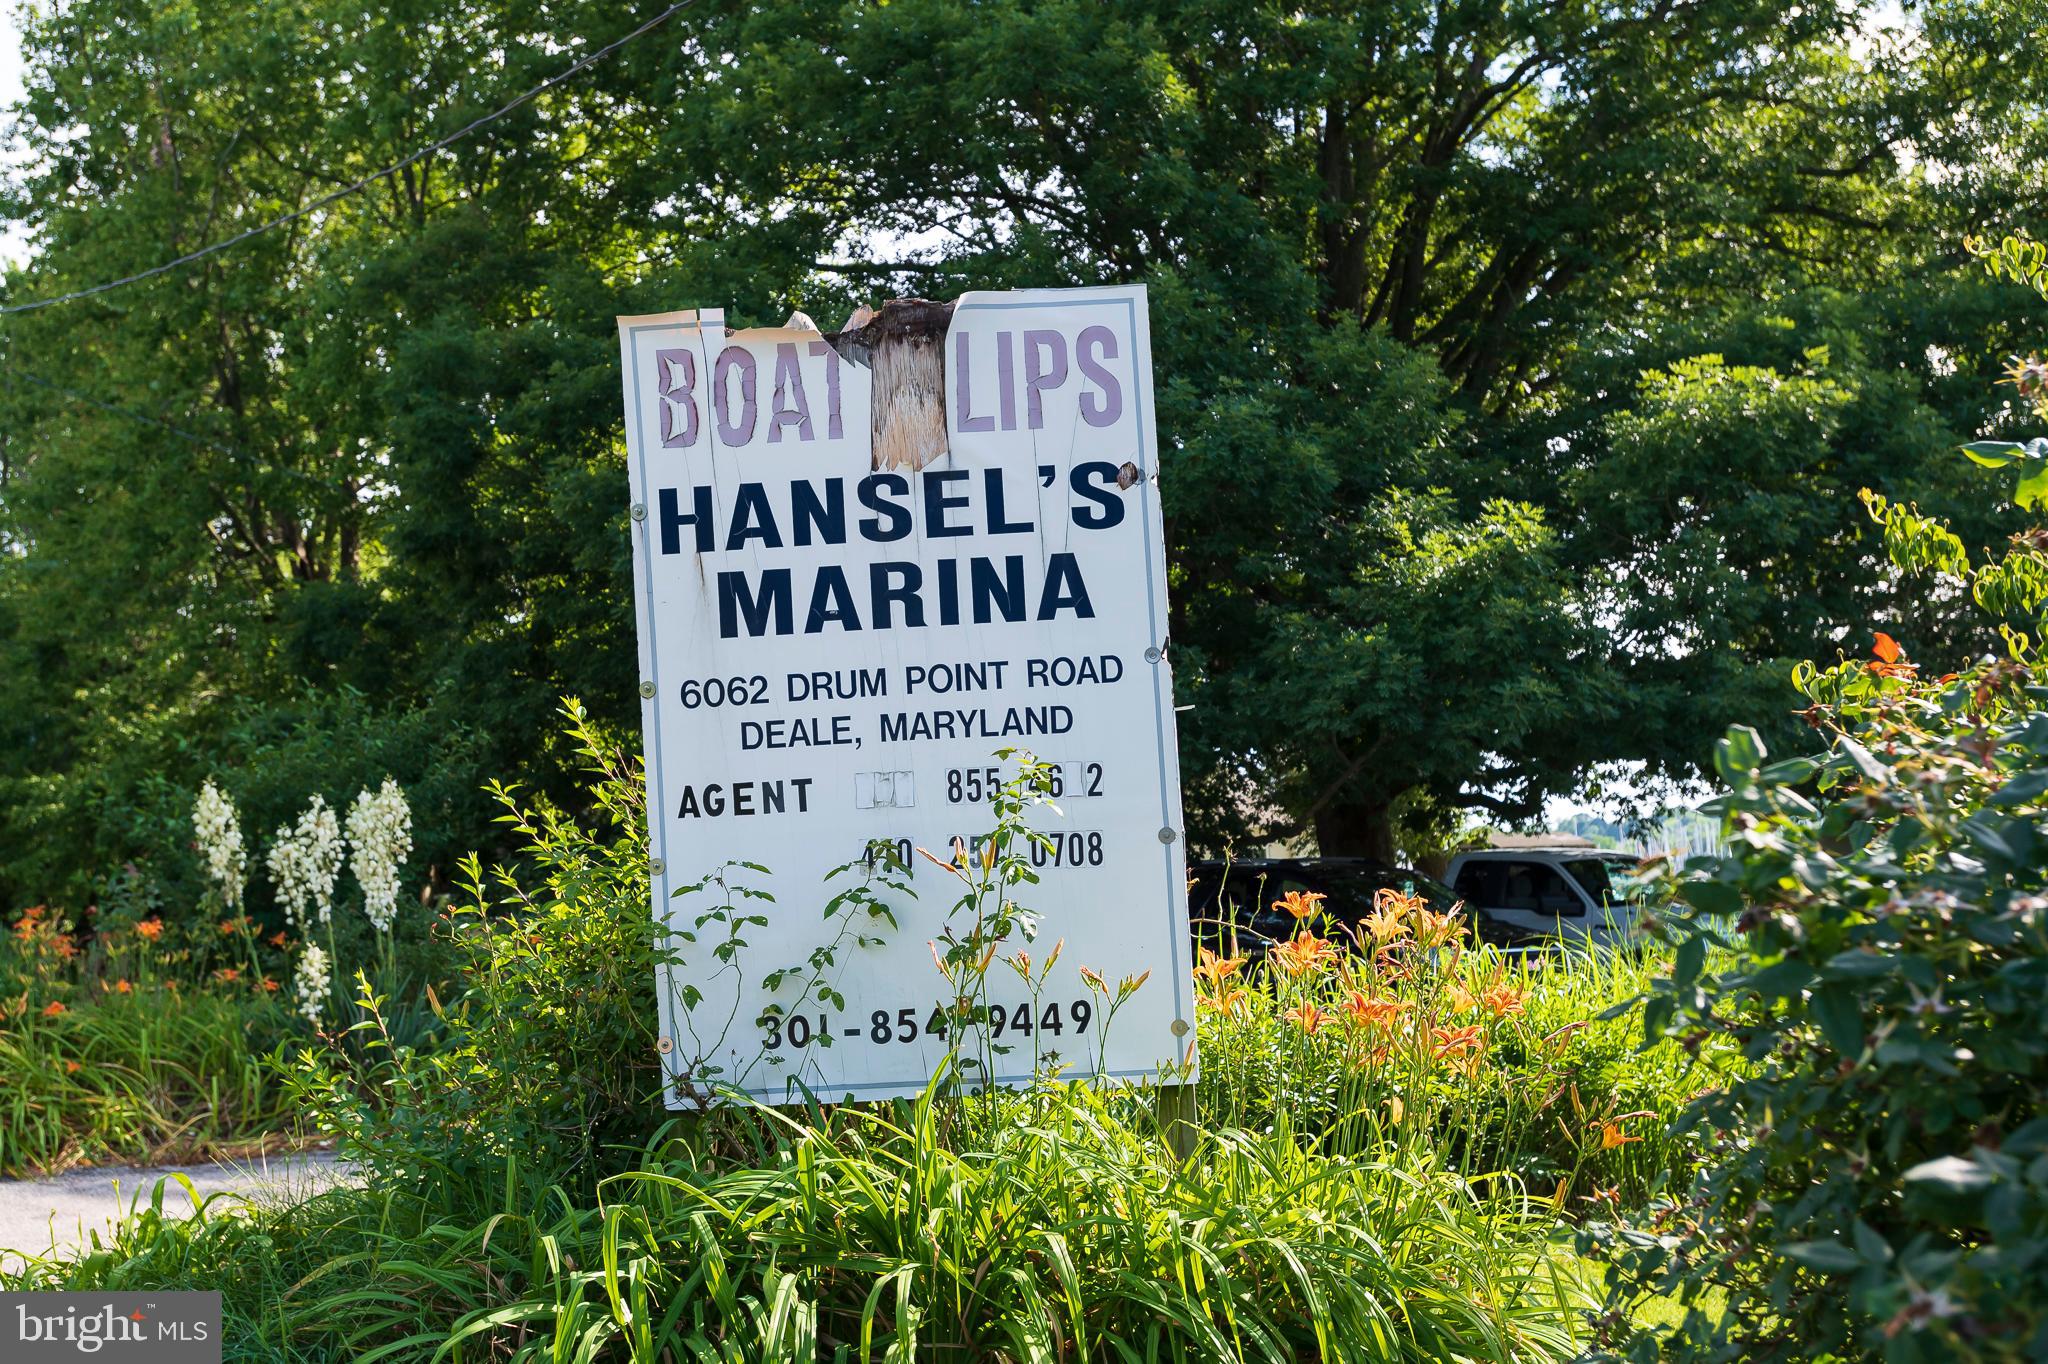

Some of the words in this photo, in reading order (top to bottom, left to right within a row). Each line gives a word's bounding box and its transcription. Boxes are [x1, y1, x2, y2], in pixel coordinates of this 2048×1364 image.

[656, 342, 844, 449] BOAT
[658, 461, 1126, 555] HANSEL'S
[717, 552, 1096, 639] MARINA
[680, 675, 770, 709] 6062
[787, 667, 888, 702] DRUM
[906, 660, 1009, 695] POINT
[1027, 655, 1124, 688] ROAD
[740, 715, 862, 750] DEALE,
[880, 705, 1074, 743] MARYLAND
[678, 778, 813, 819] AGENT
[947, 767, 1001, 804] 855
